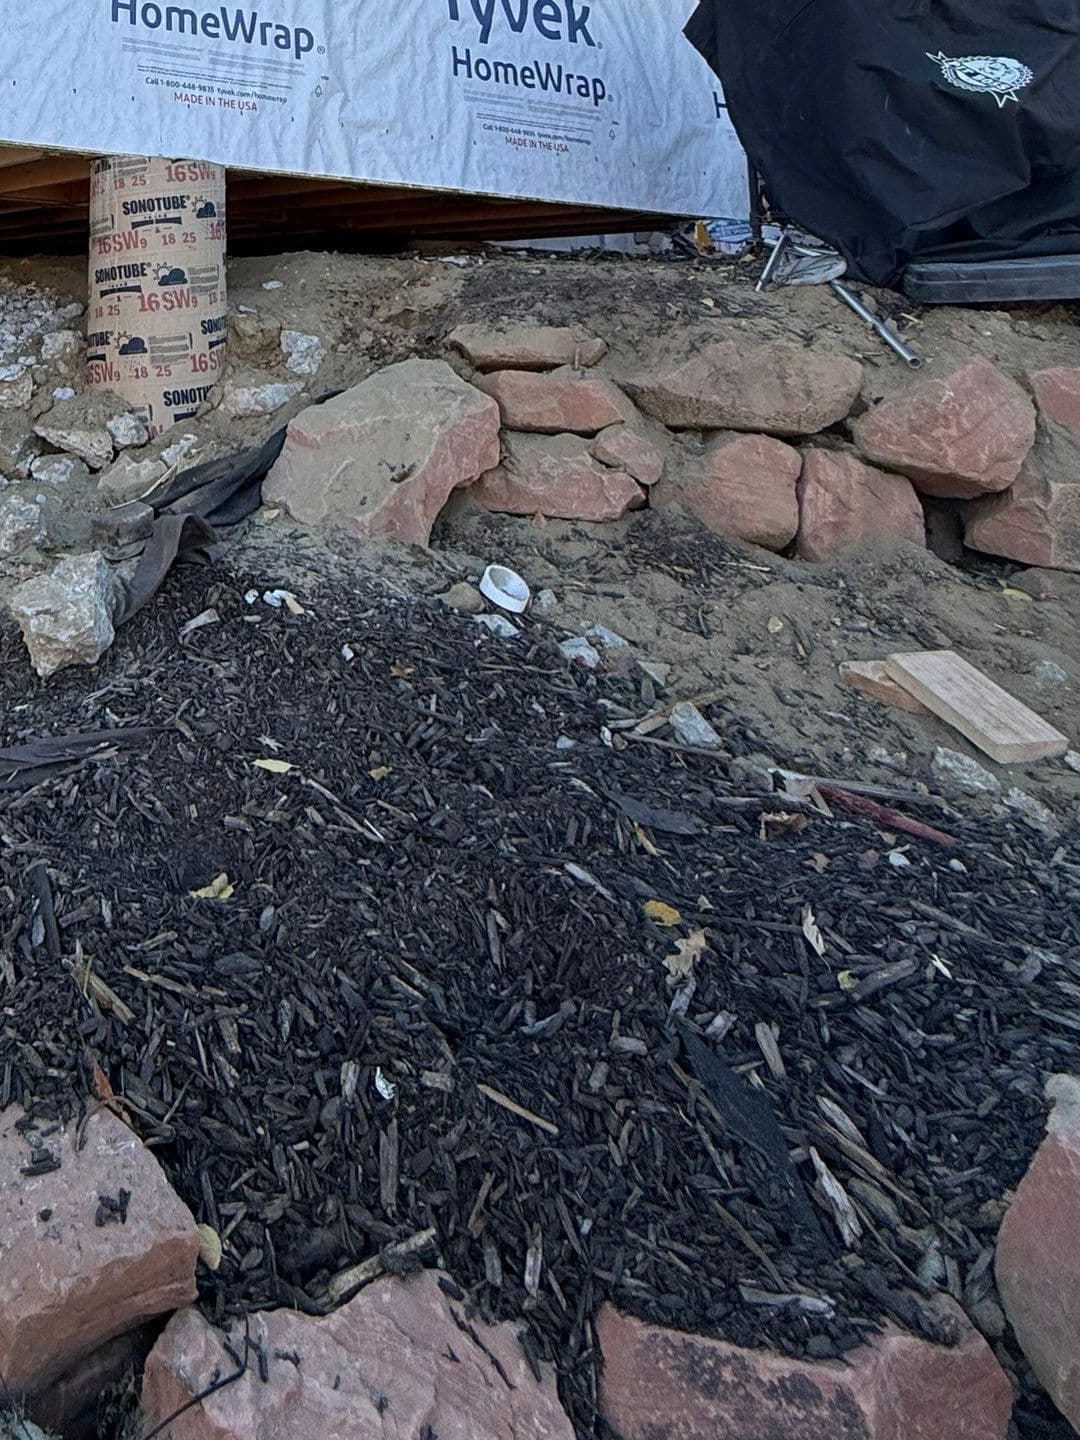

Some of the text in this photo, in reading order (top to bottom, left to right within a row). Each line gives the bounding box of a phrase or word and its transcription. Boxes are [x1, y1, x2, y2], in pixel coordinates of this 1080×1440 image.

[174, 92, 258, 112] MADE IN THE USA
[505, 136, 527, 148] MADE
[539, 141, 552, 151] THE
